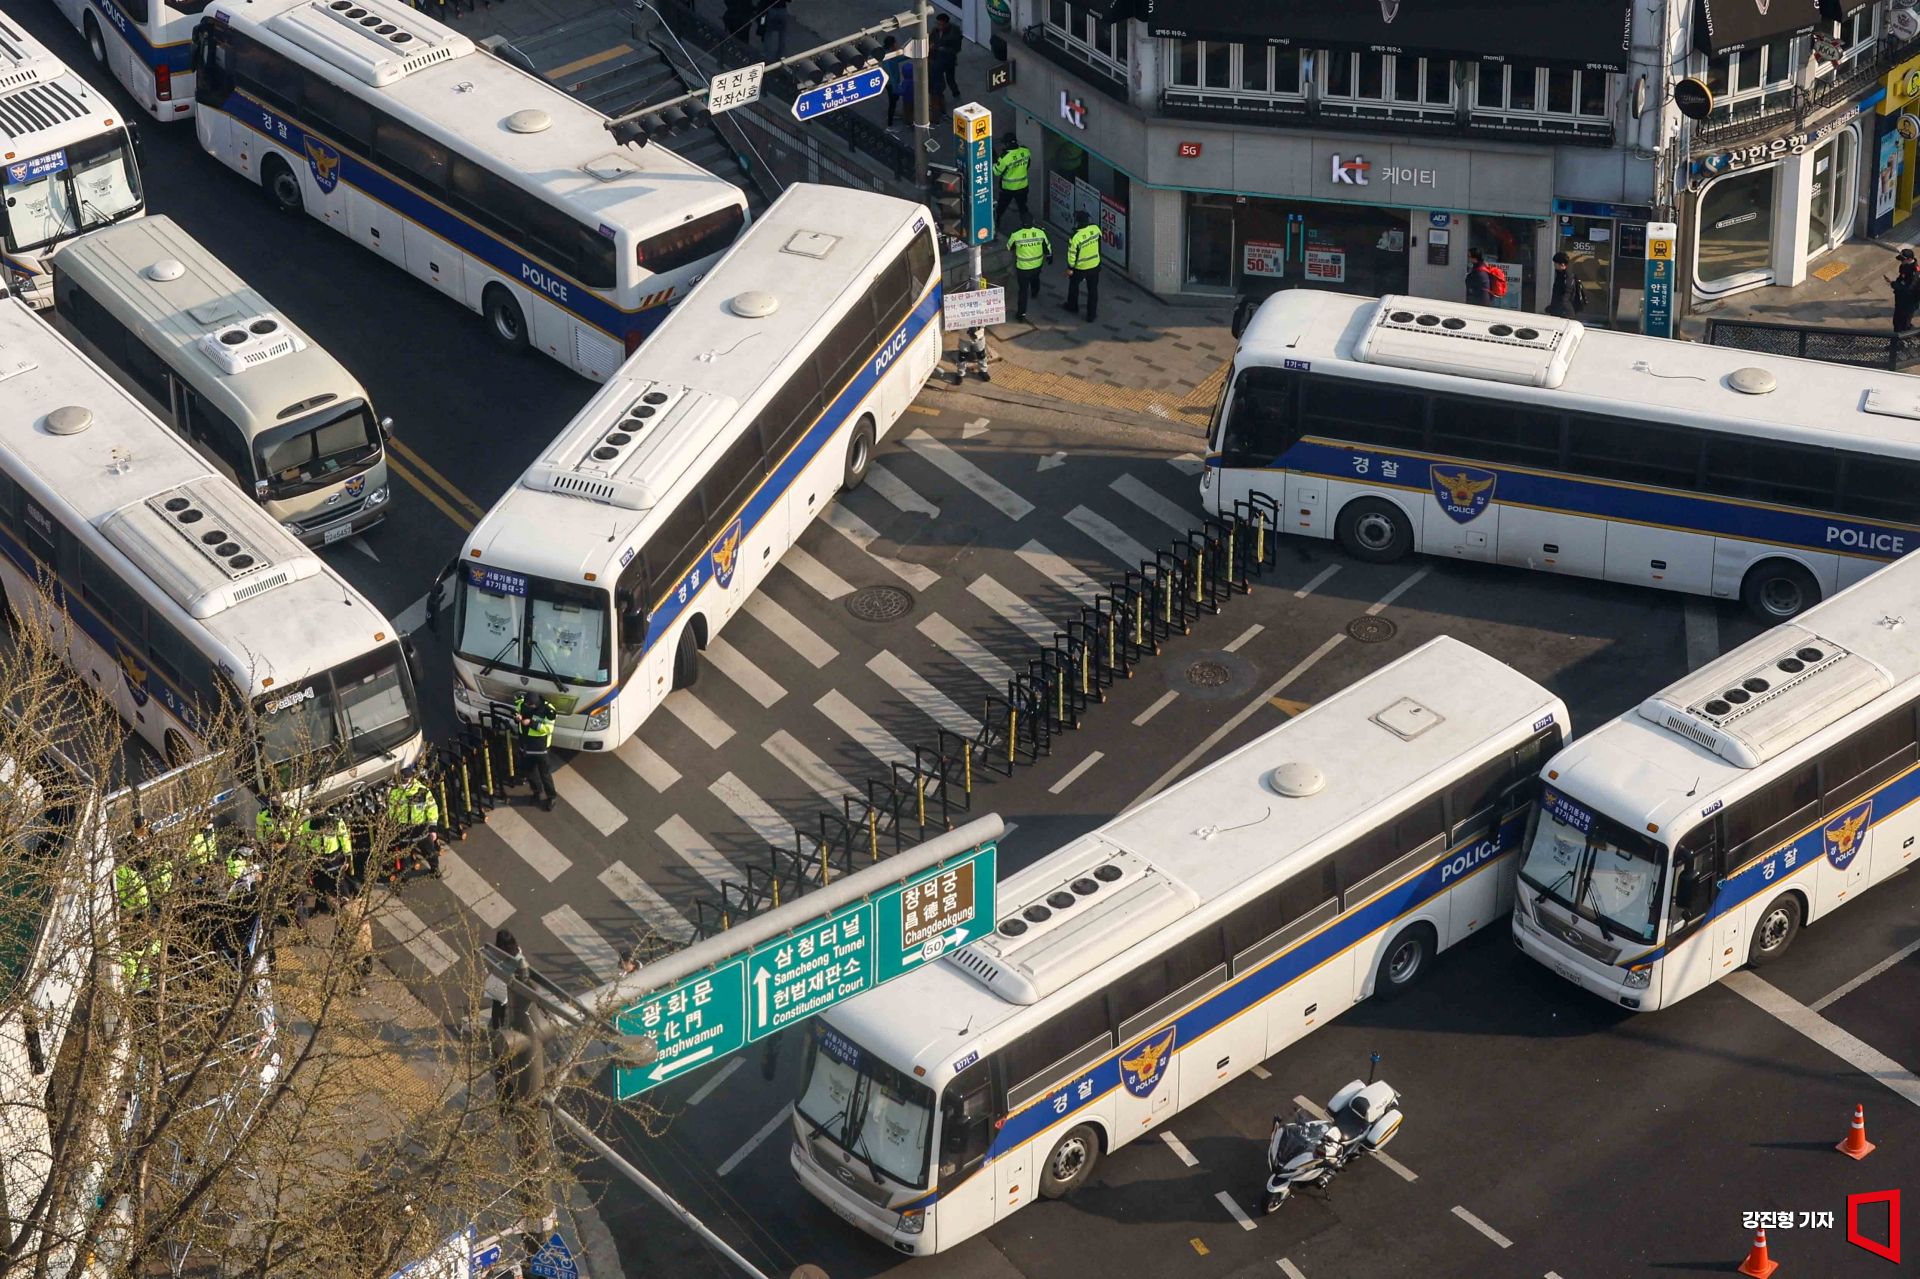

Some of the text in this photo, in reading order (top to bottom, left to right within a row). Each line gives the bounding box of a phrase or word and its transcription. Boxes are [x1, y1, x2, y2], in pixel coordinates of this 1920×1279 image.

[1622, 8, 1631, 50] GUINNESS
[1268, 37, 1290, 45] momiji
[1483, 54, 1505, 62] momiji
[869, 76, 881, 88] 65
[992, 70, 1007, 86] kt
[712, 84, 757, 108] 직좌신호
[821, 93, 860, 110] Yulgok-ro
[823, 81, 857, 101] 율곡로
[799, 101, 810, 112] 61
[1061, 91, 1086, 131] kt
[978, 141, 985, 150] 2
[1182, 146, 1197, 156] 5G
[1728, 134, 1808, 170] 신한은행
[1332, 155, 1370, 186] kt
[1382, 166, 1436, 188] 케이티
[1247, 258, 1265, 271] 50
[1656, 261, 1665, 271] 3
[522, 263, 568, 302] POLICE
[1650, 284, 1661, 306] 안국
[875, 328, 907, 376] POLICE
[1447, 505, 1475, 515] POLICE
[1826, 526, 1904, 553] POLICE
[485, 580, 525, 594] 87기동대-2
[486, 571, 525, 587] 서울기동경찰
[1554, 807, 1589, 831] 87기동대-3
[1558, 799, 1591, 823] 서울기동경찰
[1835, 847, 1856, 864] POLICE
[905, 870, 958, 911] 창덕궁
[905, 906, 974, 945] Changdeokgung
[926, 943, 942, 955] 50
[774, 935, 865, 987] Samcheong Tunnel
[773, 957, 861, 1010] 헌법재판소
[641, 979, 713, 1027] 광화문
[772, 976, 864, 1026] Constitutional Court
[956, 1053, 977, 1071] 87기-1
[1135, 1075, 1160, 1093] POLICE
